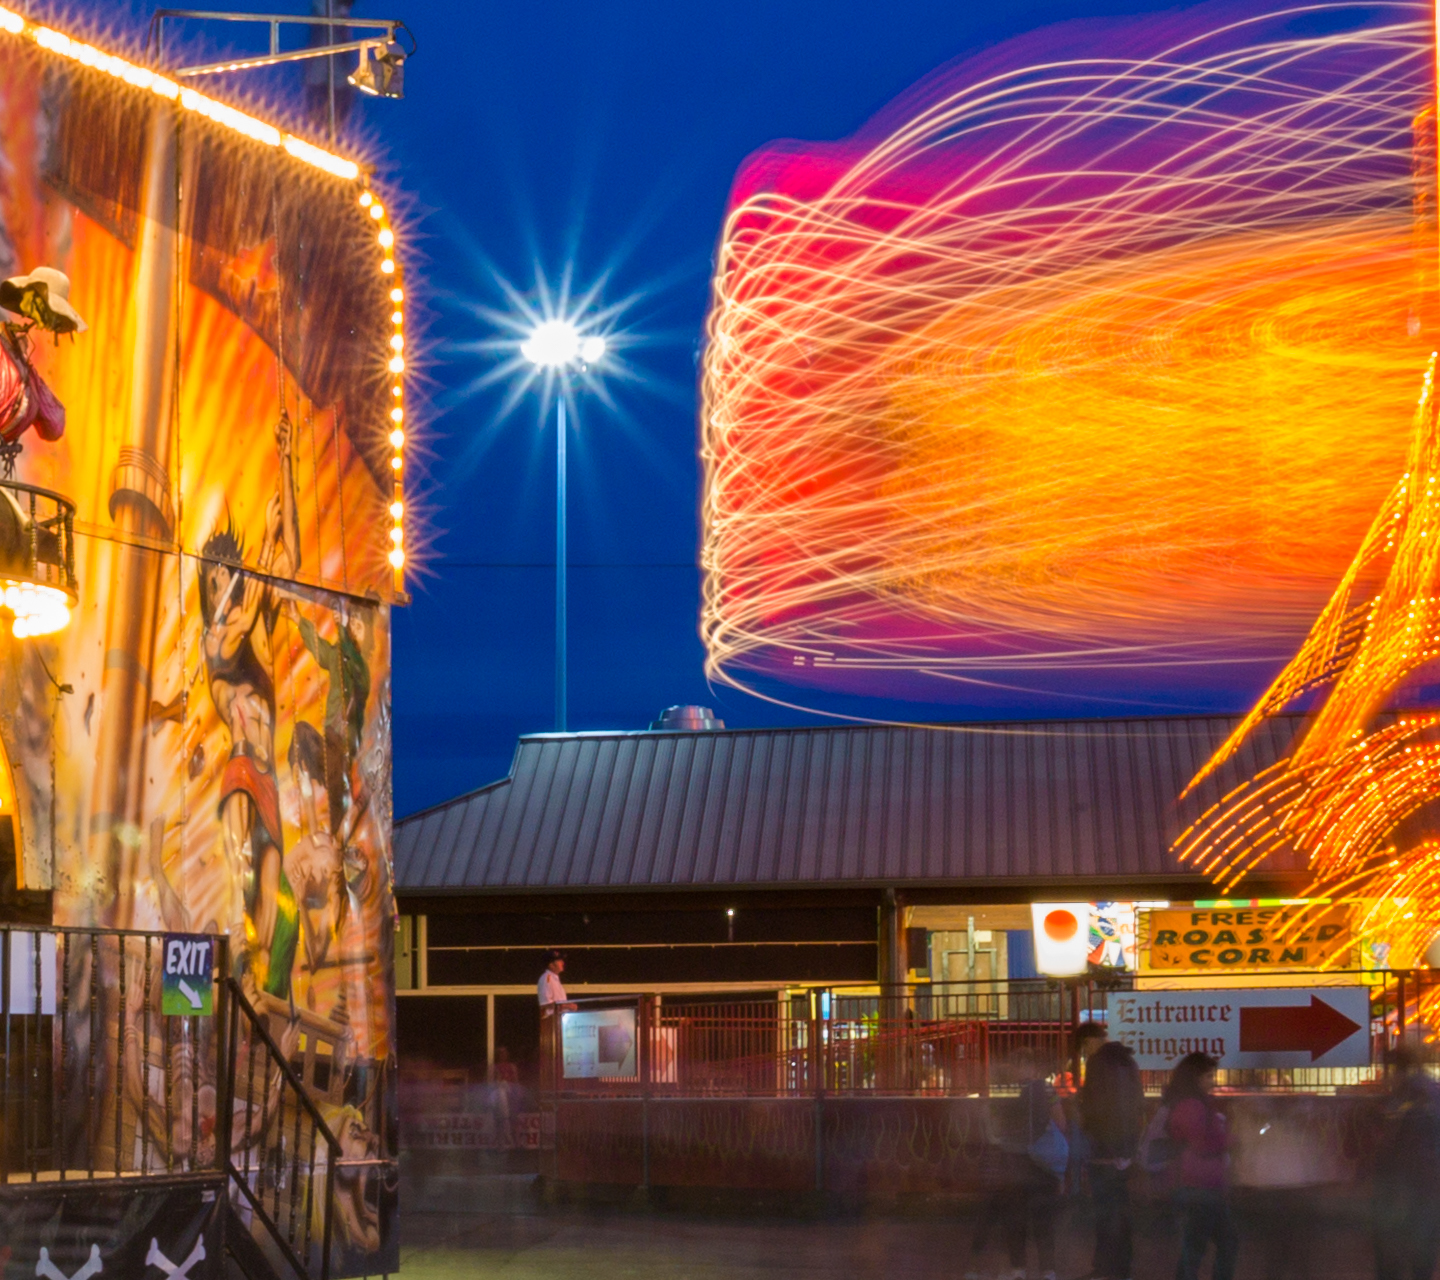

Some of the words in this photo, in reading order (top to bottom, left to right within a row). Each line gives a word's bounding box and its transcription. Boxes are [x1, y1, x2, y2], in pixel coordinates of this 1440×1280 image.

[1191, 911, 1309, 927] FRESH
[166, 940, 210, 975] EXIT
[1189, 947, 1307, 965] CORN
[1116, 999, 1233, 1024] Entrance
